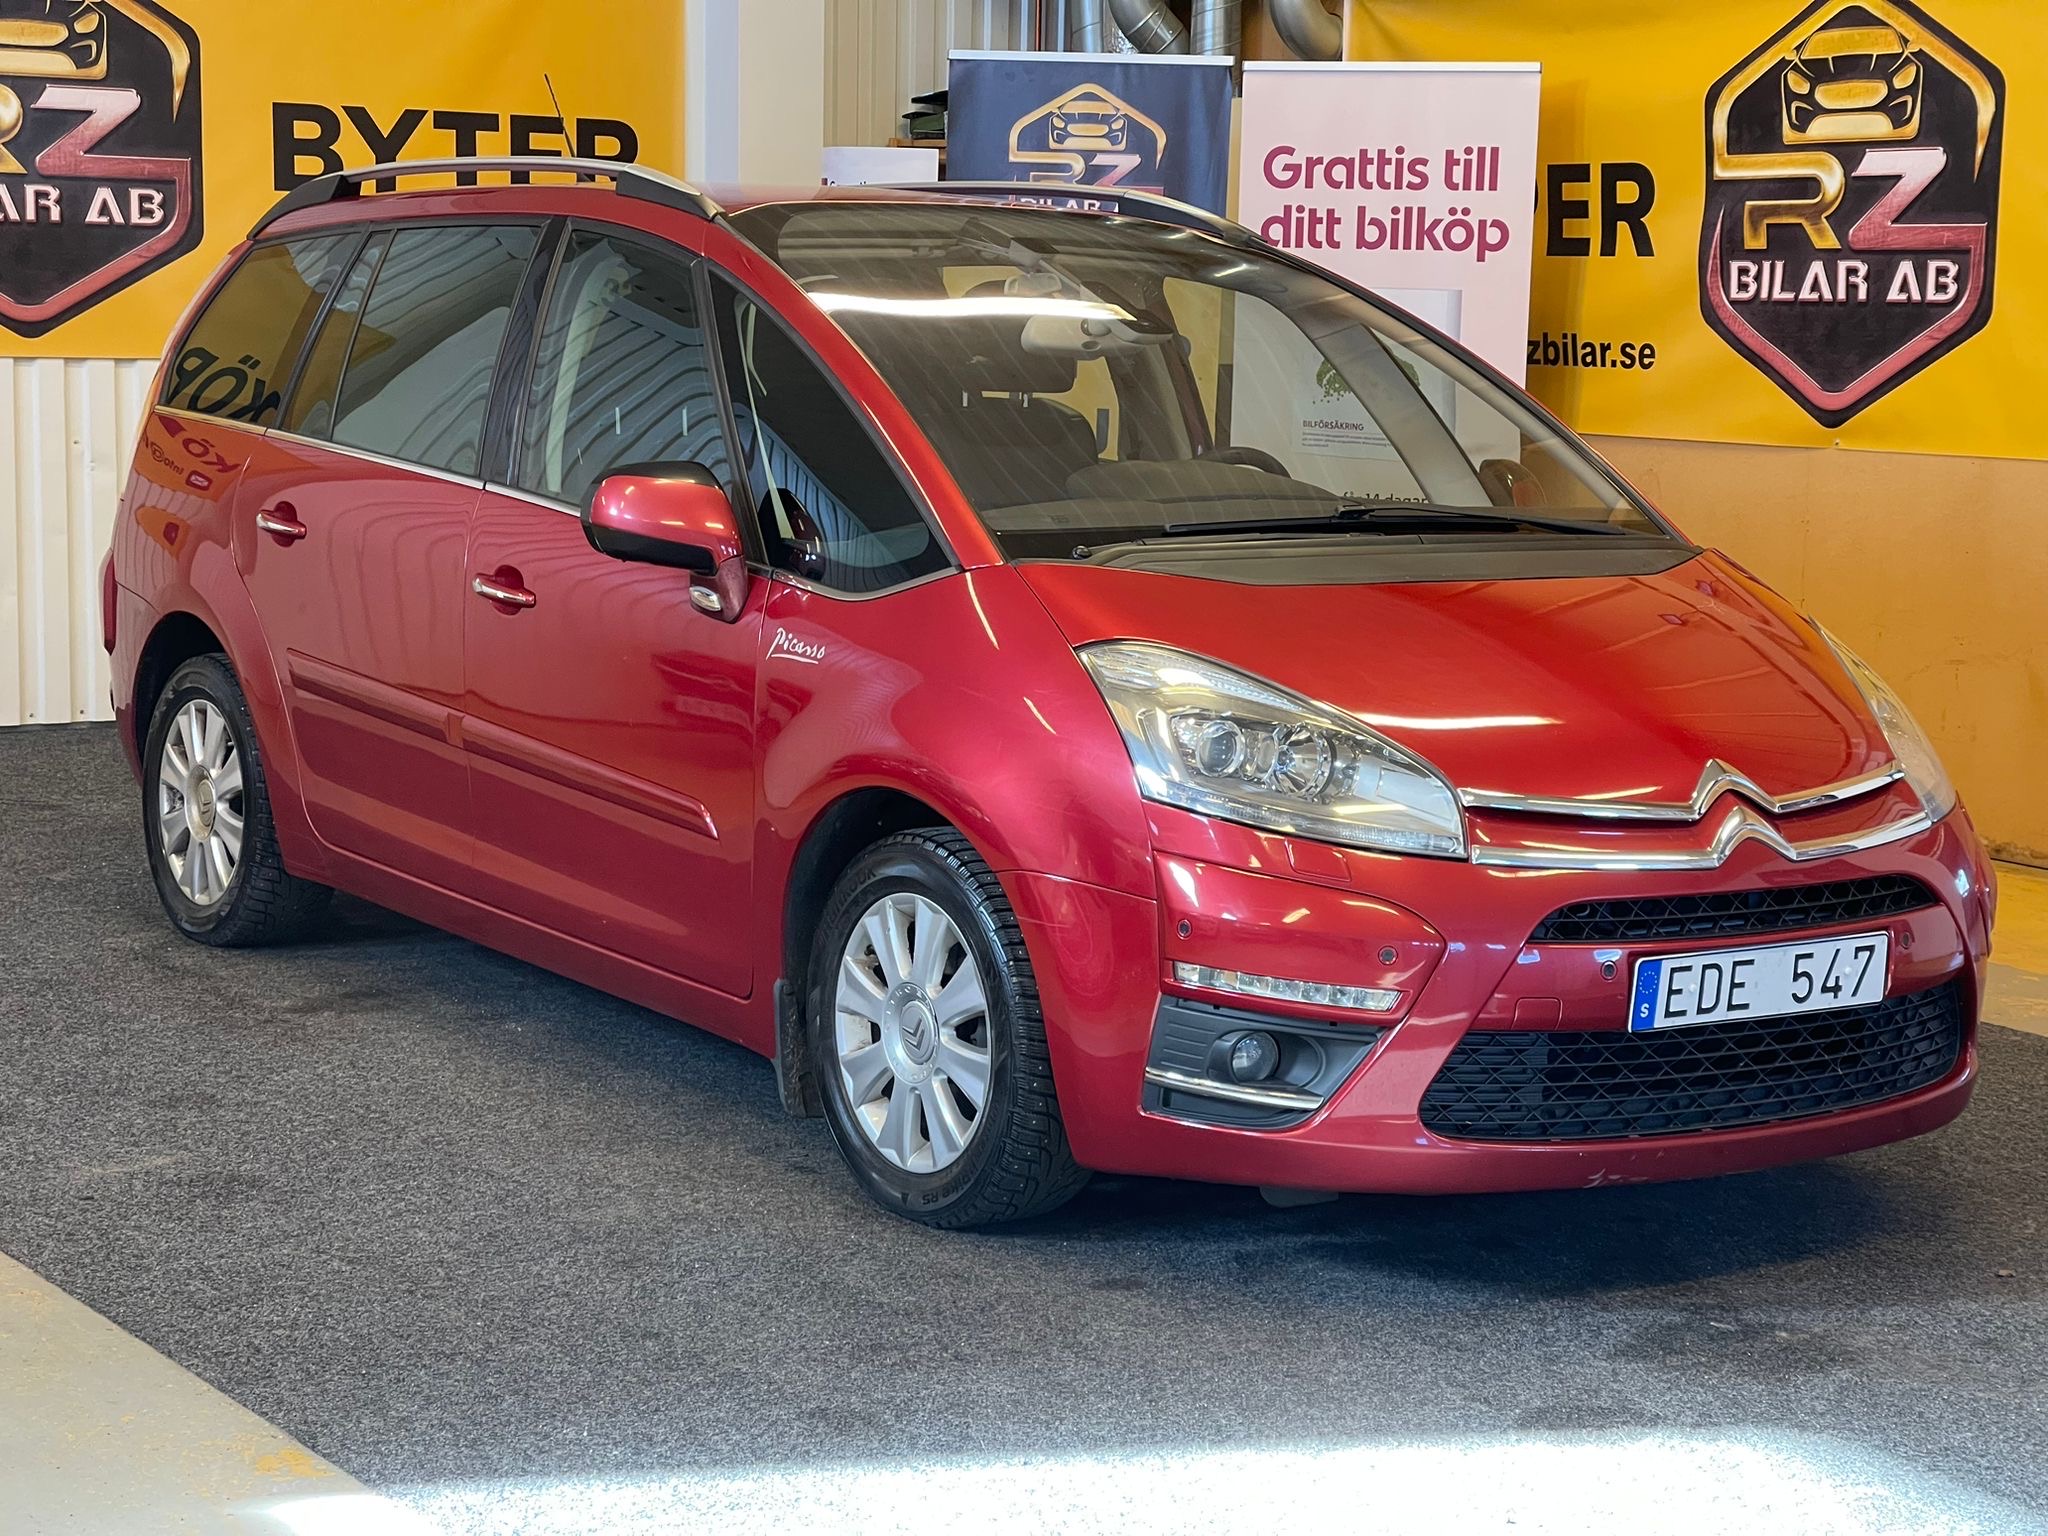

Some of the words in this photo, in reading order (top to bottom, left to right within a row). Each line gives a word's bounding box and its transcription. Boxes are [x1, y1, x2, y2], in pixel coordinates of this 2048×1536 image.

[1263, 145, 1430, 191] Grattis
[1444, 146, 1500, 191] till
[85, 187, 165, 227] AB
[1534, 162, 1656, 257] ER
[1260, 204, 1342, 249] ditt
[1356, 206, 1510, 263] bilköp
[1729, 260, 1870, 303] BILAR
[1886, 260, 1960, 303] AB
[1302, 420, 1365, 431] BILFÖRSÄKRING
[765, 627, 826, 661] Picasso
[1664, 959, 1755, 1019] EDE
[1791, 944, 1876, 1004] 547
[1640, 1003, 1650, 1018] S
